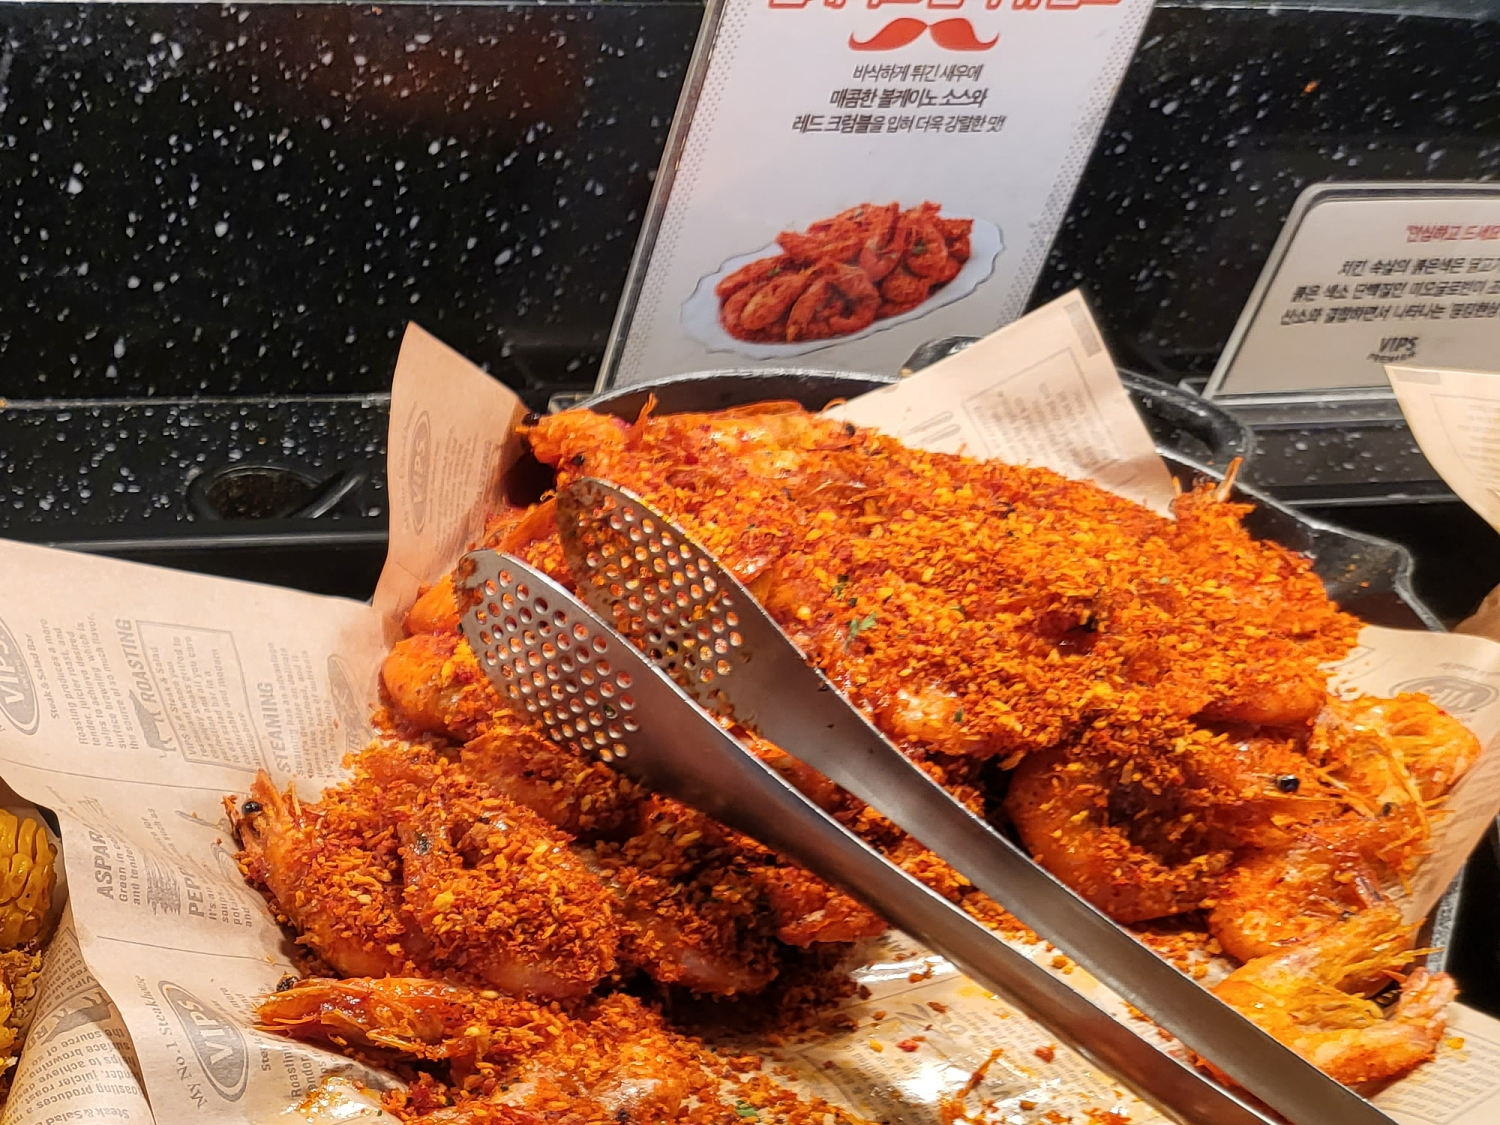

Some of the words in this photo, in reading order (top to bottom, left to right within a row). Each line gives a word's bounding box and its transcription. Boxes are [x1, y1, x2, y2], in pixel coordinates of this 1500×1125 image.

[853, 64, 910, 82] 바삭하게
[911, 64, 940, 82] 튀긴
[939, 64, 983, 81] 새우에
[830, 89, 877, 108] 매콤한
[877, 88, 938, 108] 볼케이노
[939, 88, 989, 108] 소스와
[915, 115, 944, 132] 더욱
[945, 115, 987, 132] 강렬한
[1379, 337, 1419, 352] VIPS
[23, 631, 36, 652] Bar
[29, 651, 46, 681] Salad
[112, 615, 157, 707] ROASTING
[43, 690, 59, 720] Steak
[255, 683, 292, 776] STEAMING
[118, 866, 127, 901] Green
[176, 997, 233, 1065] VIPS
[184, 1084, 208, 1108] My
[94, 1108, 130, 1119] Steak
